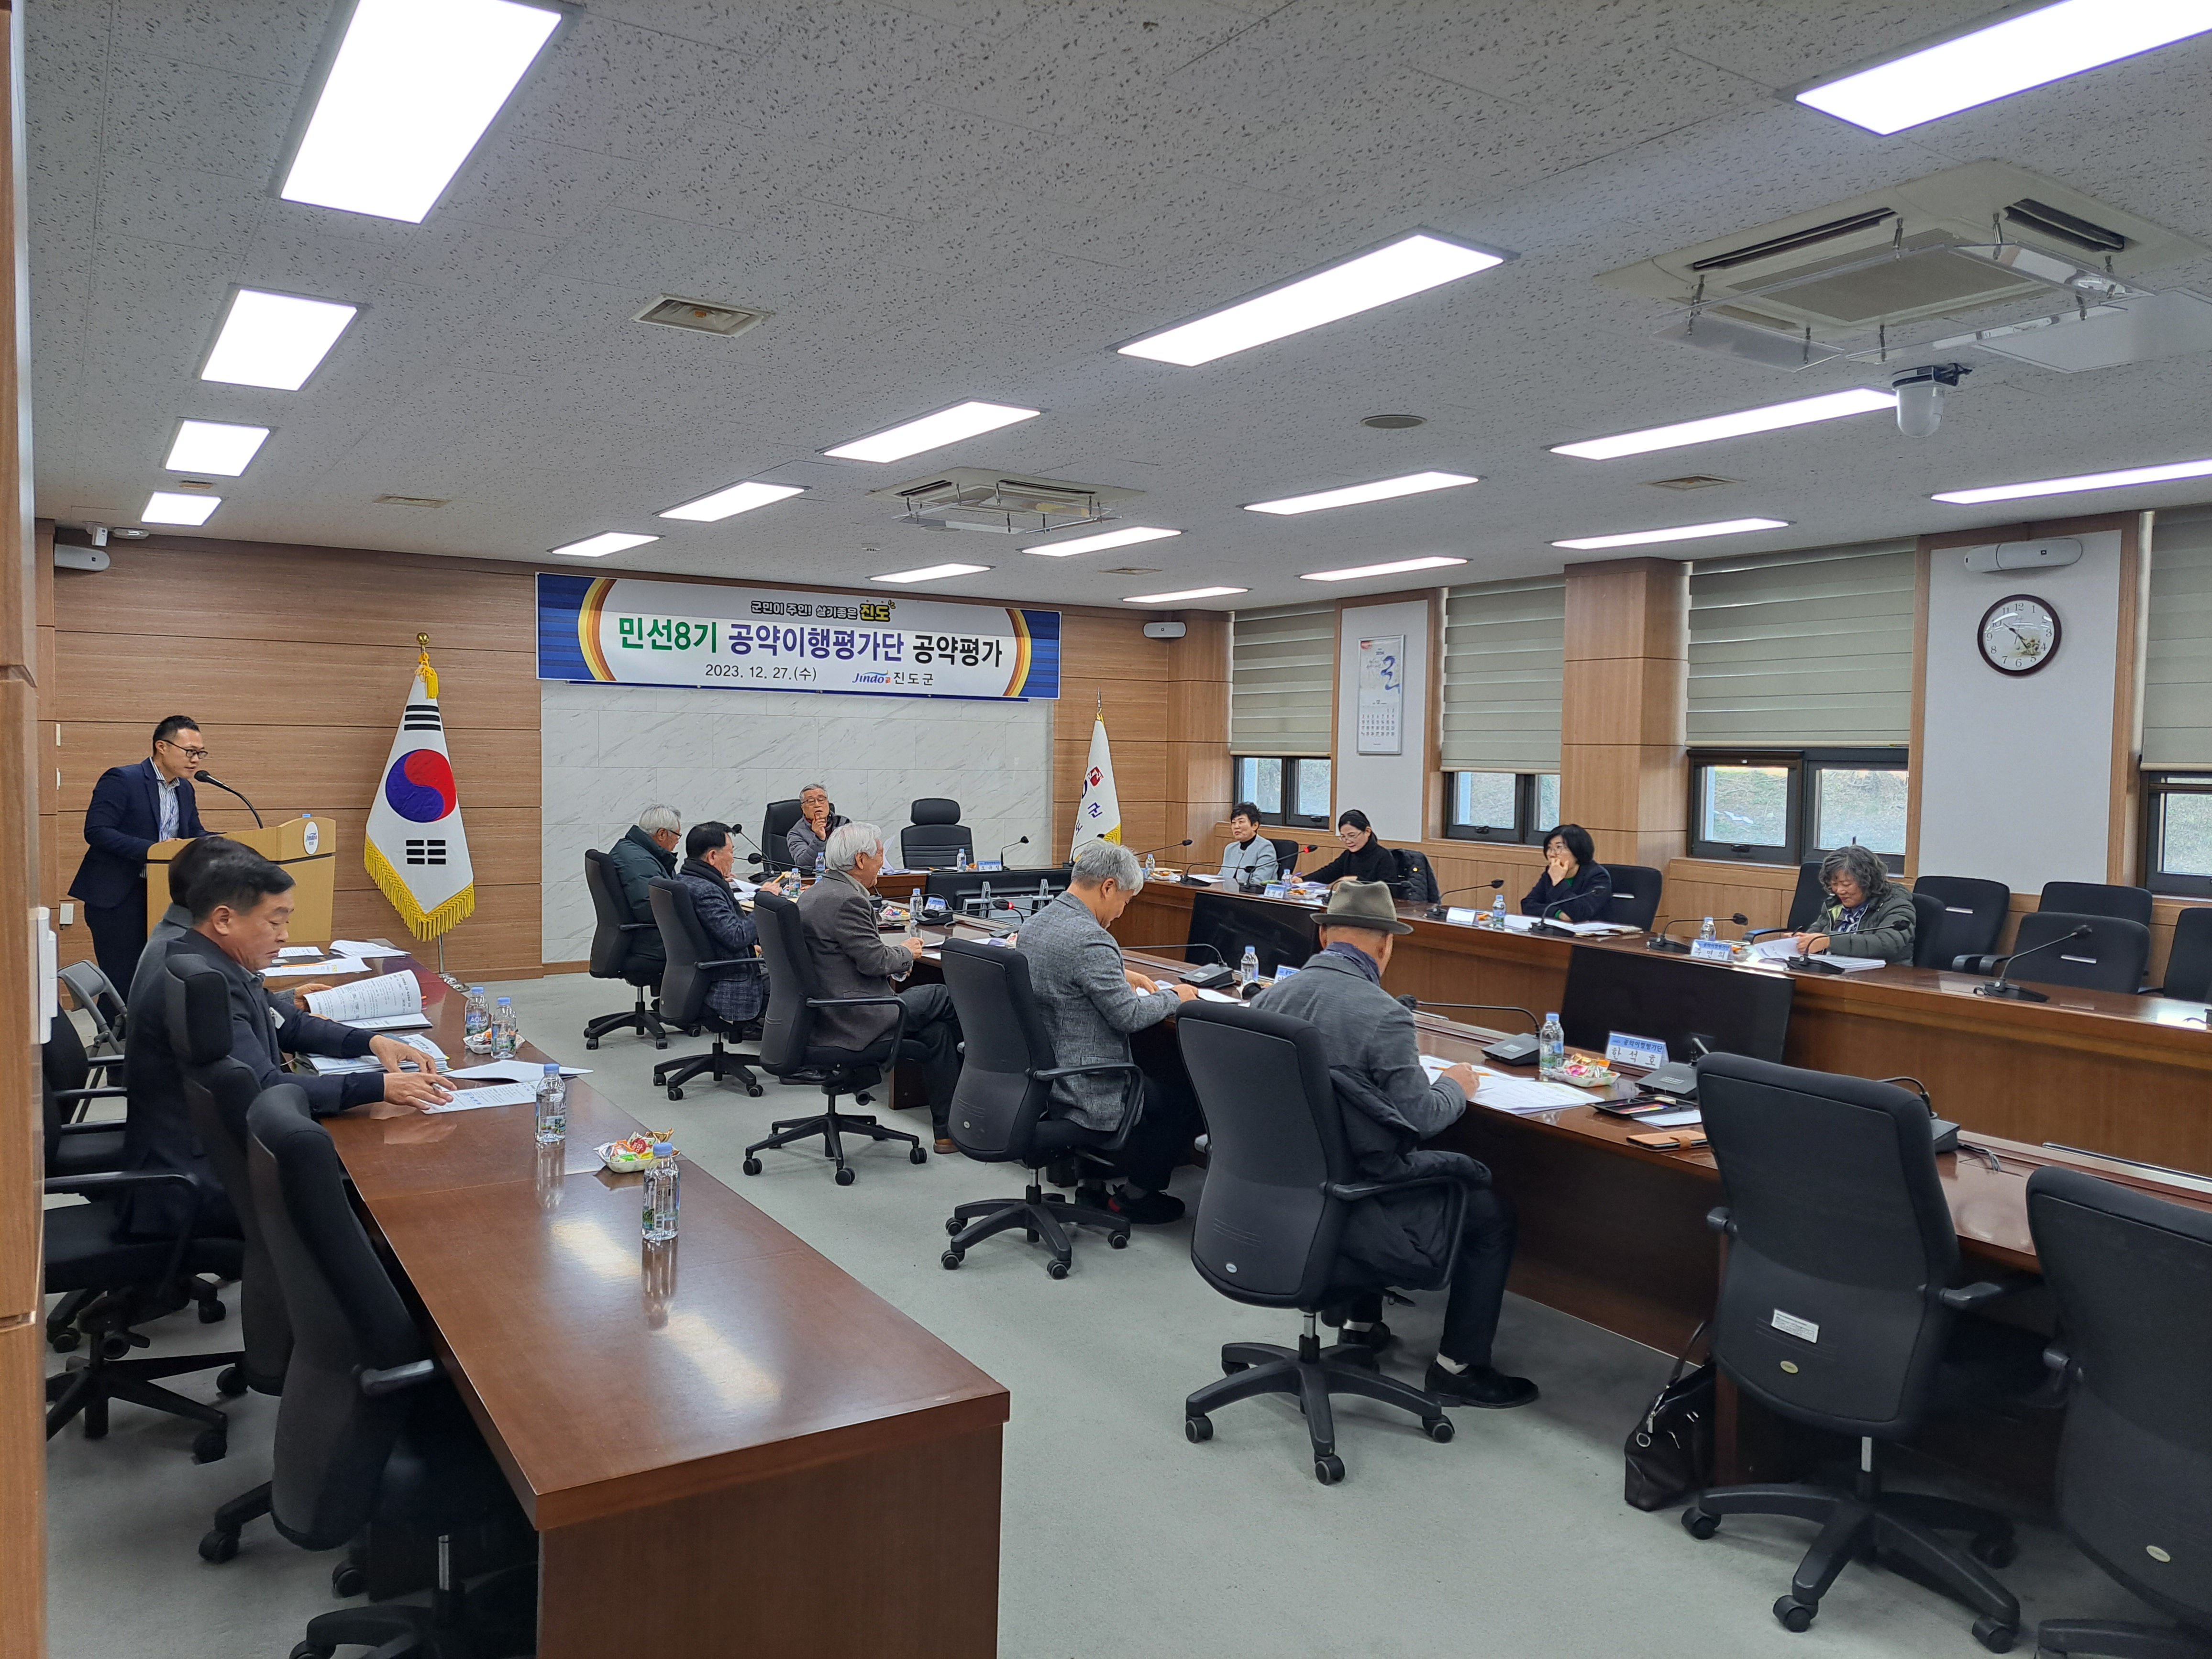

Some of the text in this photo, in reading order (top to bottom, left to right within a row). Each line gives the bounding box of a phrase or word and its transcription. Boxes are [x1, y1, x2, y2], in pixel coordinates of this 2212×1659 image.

[2014, 603, 2024, 611] 12
[2032, 605, 2035, 613] 1
[752, 601, 890, 622] 군민이 주인! 살기좋은 진도
[1987, 633, 1992, 641] 9
[2046, 629, 2052, 637] 3
[619, 618, 1002, 667] 민선8기 공약이행평가단 공약평가
[2040, 642, 2047, 651] 4
[1991, 646, 1997, 654] 8
[2002, 656, 2008, 664] 7
[2015, 659, 2022, 667] 6
[705, 664, 743, 678] 2023.
[750, 666, 767, 679] 12.
[852, 672, 885, 684] Jindo
[893, 672, 933, 686] 진도군
